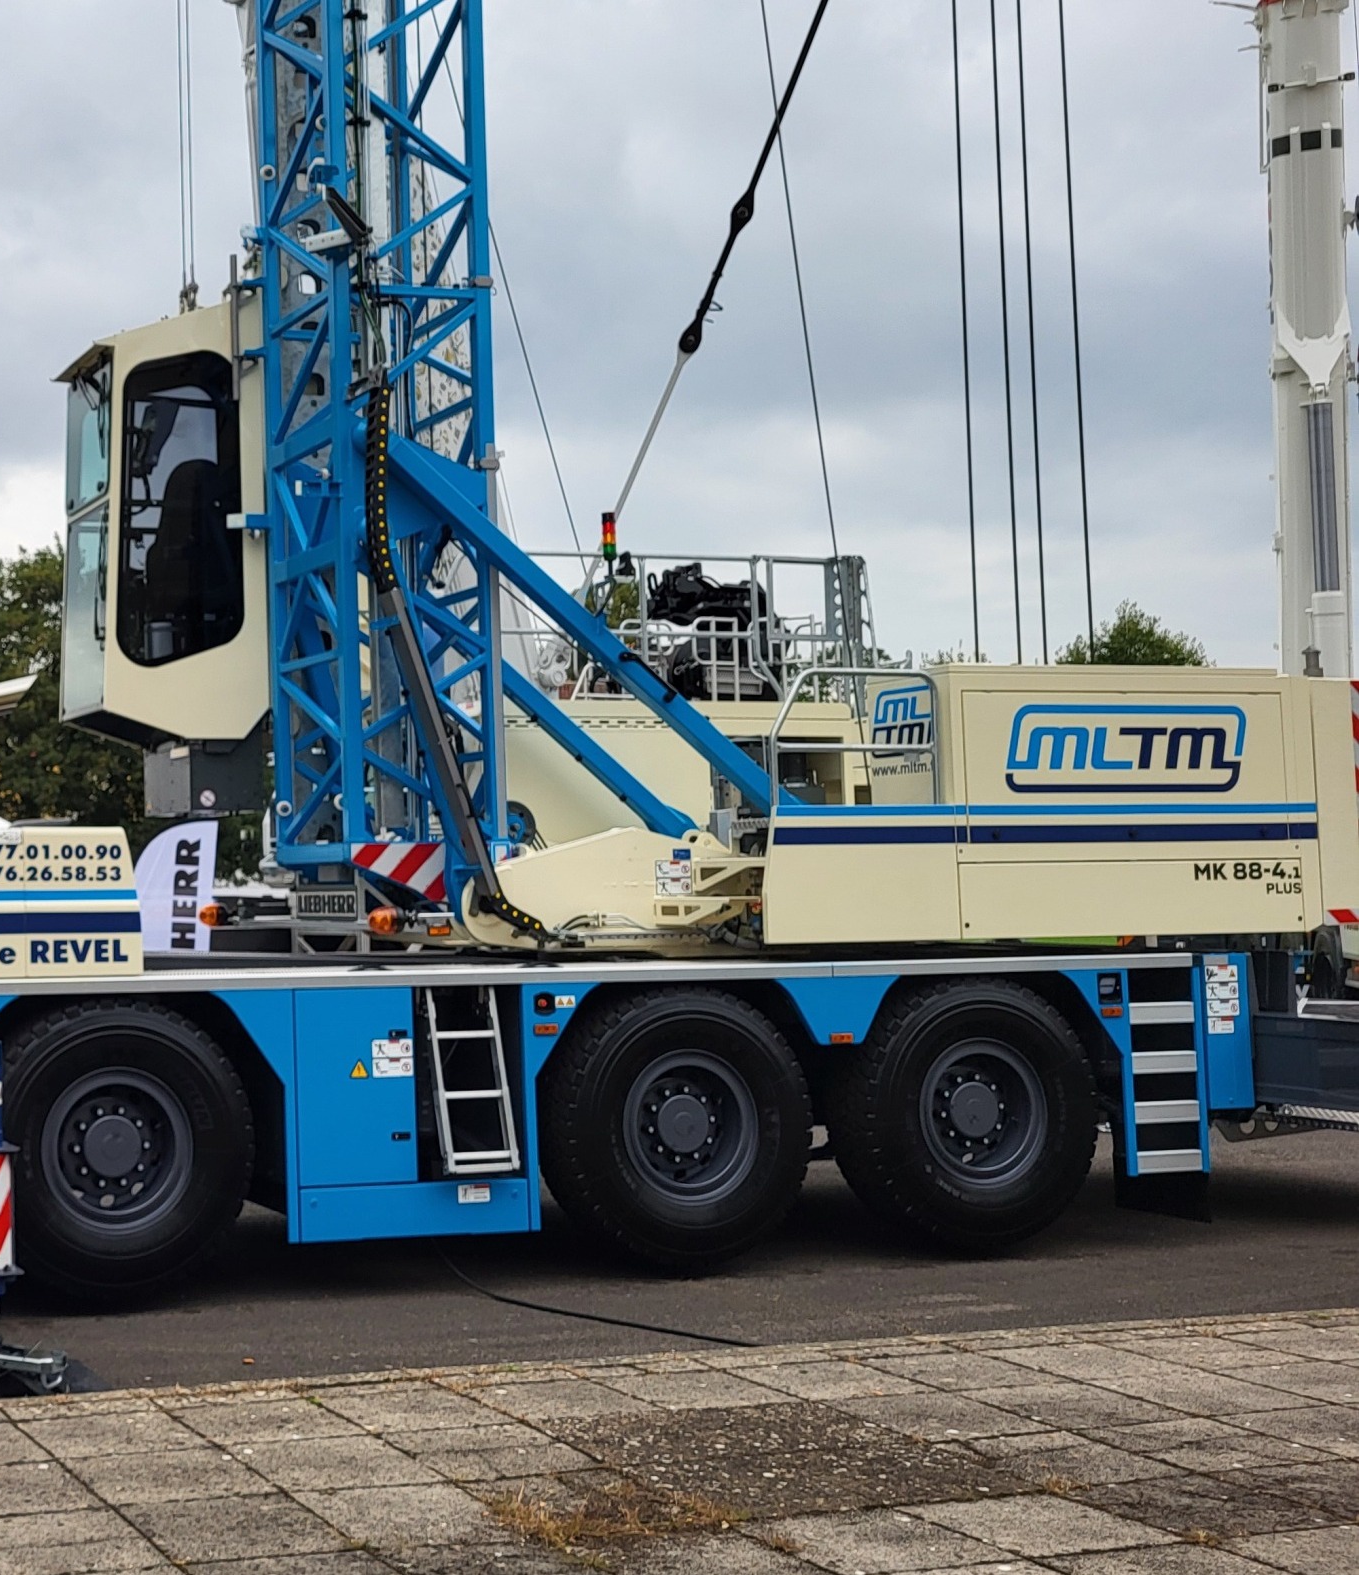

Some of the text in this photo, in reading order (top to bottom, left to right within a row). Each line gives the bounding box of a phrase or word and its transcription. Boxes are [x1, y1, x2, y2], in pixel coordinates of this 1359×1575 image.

[1007, 724, 1240, 772] MLTM
[872, 761, 933, 777] www.mltm.
[1194, 862, 1301, 880] MK 88-4.1
[1266, 882, 1302, 895] PLUS
[297, 893, 357, 913] LIEBHERR
[30, 939, 128, 963] REVEL
